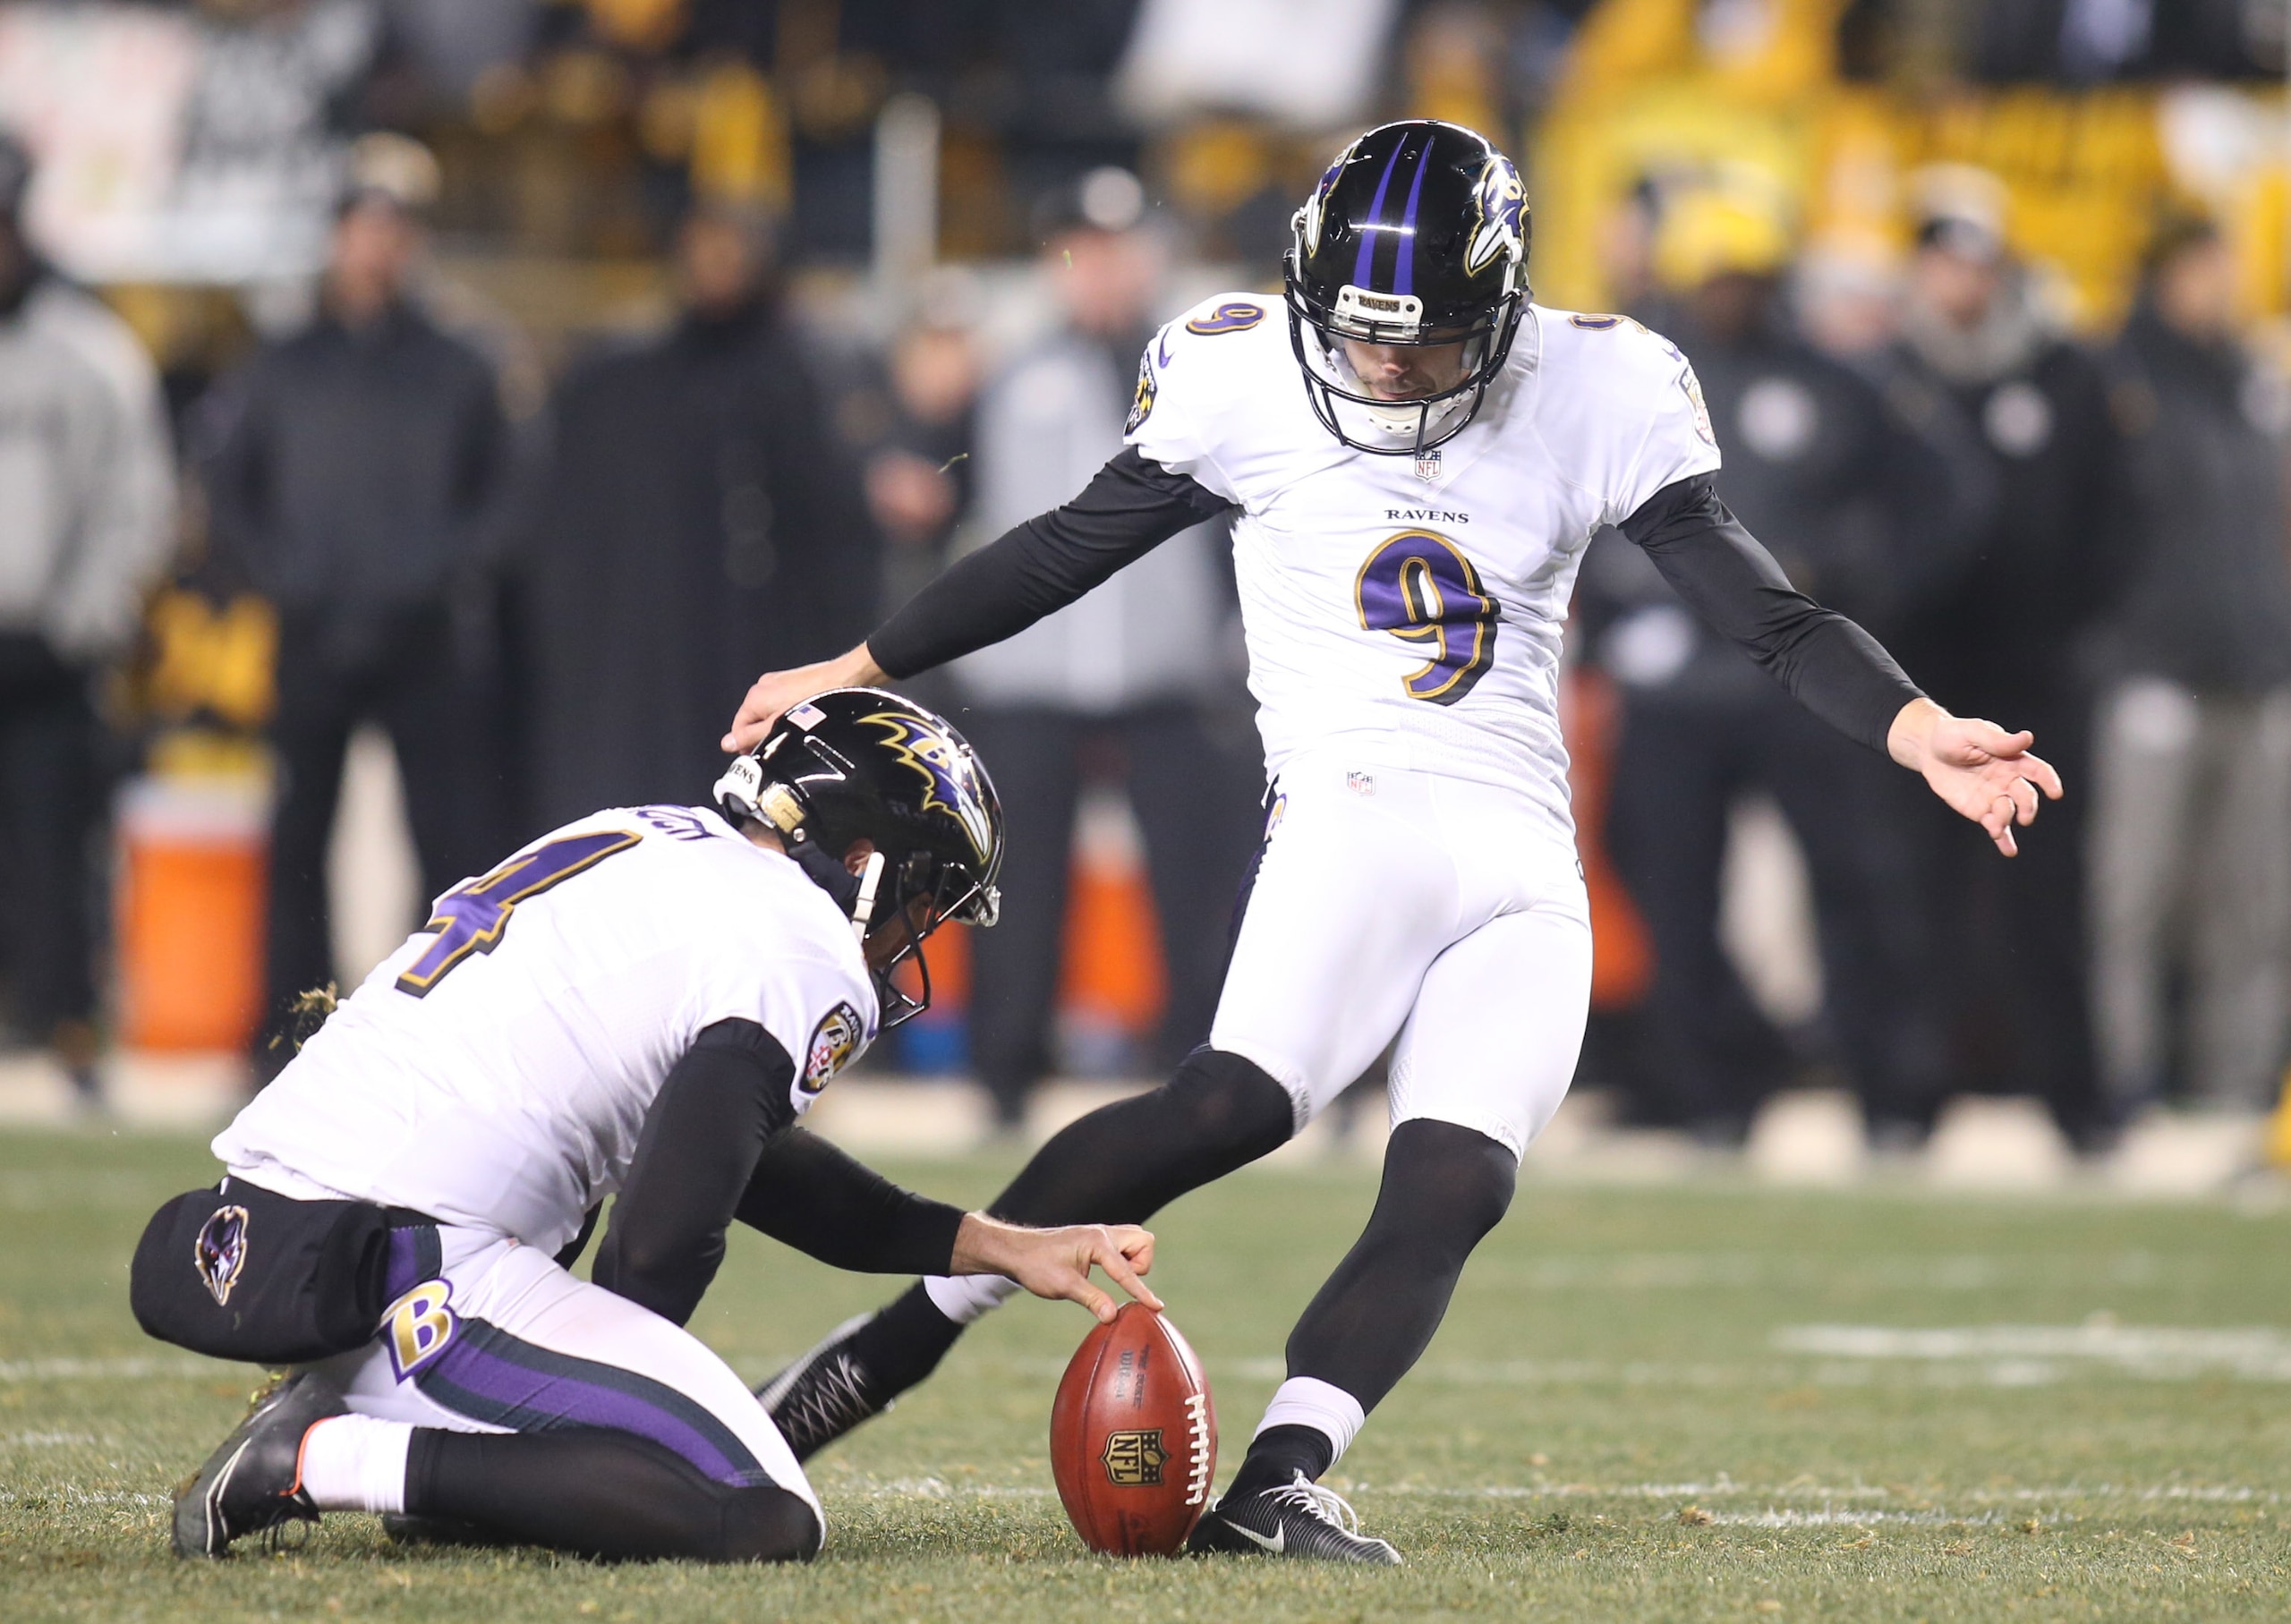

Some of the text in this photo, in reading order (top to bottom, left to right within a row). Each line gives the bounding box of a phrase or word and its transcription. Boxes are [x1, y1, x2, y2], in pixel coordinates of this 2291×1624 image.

[1185, 302, 1267, 336] 9
[1358, 294, 1401, 312] RAVENS
[1417, 460, 1439, 476] NFL
[1384, 508, 1469, 524] RAVENS
[1354, 529, 1502, 707] 9
[727, 762, 755, 784] VENS
[1350, 778, 1371, 793] NFL
[394, 829, 644, 999] 4
[378, 1277, 460, 1386] B
[1133, 1373, 1146, 1409] DUKE
[1109, 1437, 1140, 1481] NFL
